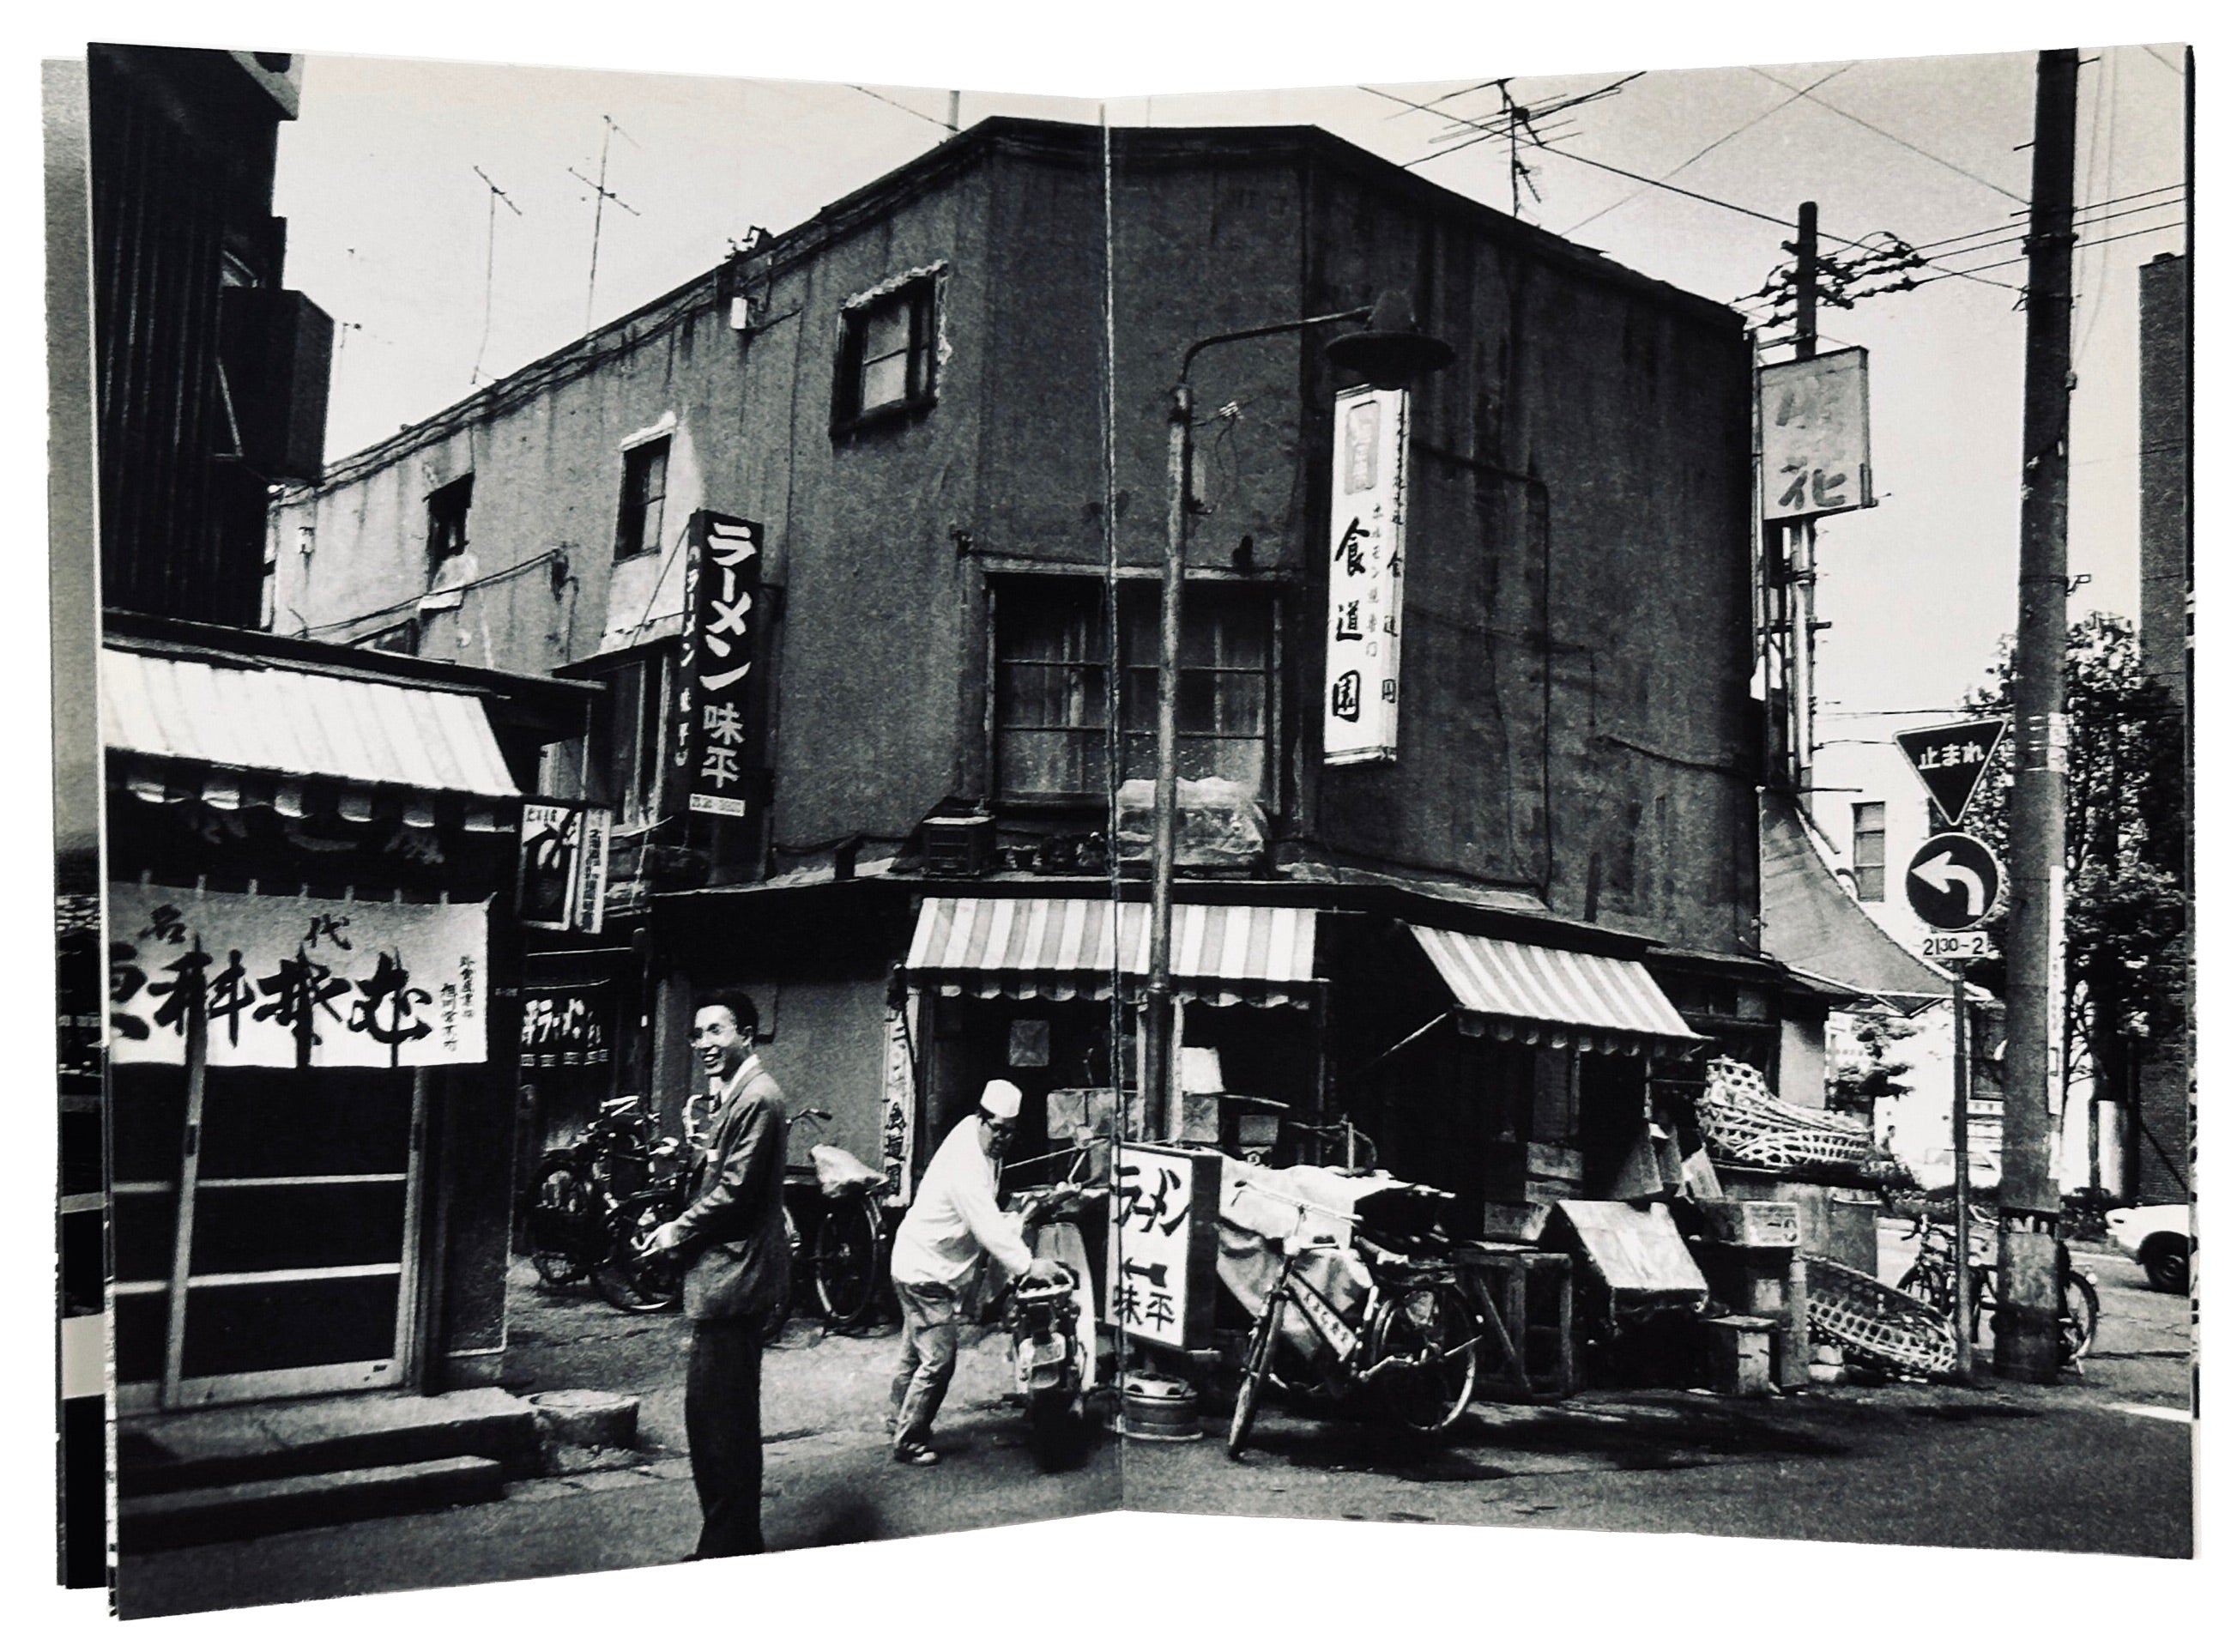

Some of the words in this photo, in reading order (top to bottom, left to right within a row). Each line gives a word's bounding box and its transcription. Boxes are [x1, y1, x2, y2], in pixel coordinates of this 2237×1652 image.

[1332, 516, 1371, 723] 食道園
[700, 700, 745, 789] 味平
[1918, 741, 1986, 771] 止まれ
[1923, 937, 1984, 956] 2130-2
[1112, 1165, 1192, 1237] ラーメン
[1113, 1285, 1176, 1332] 味平
